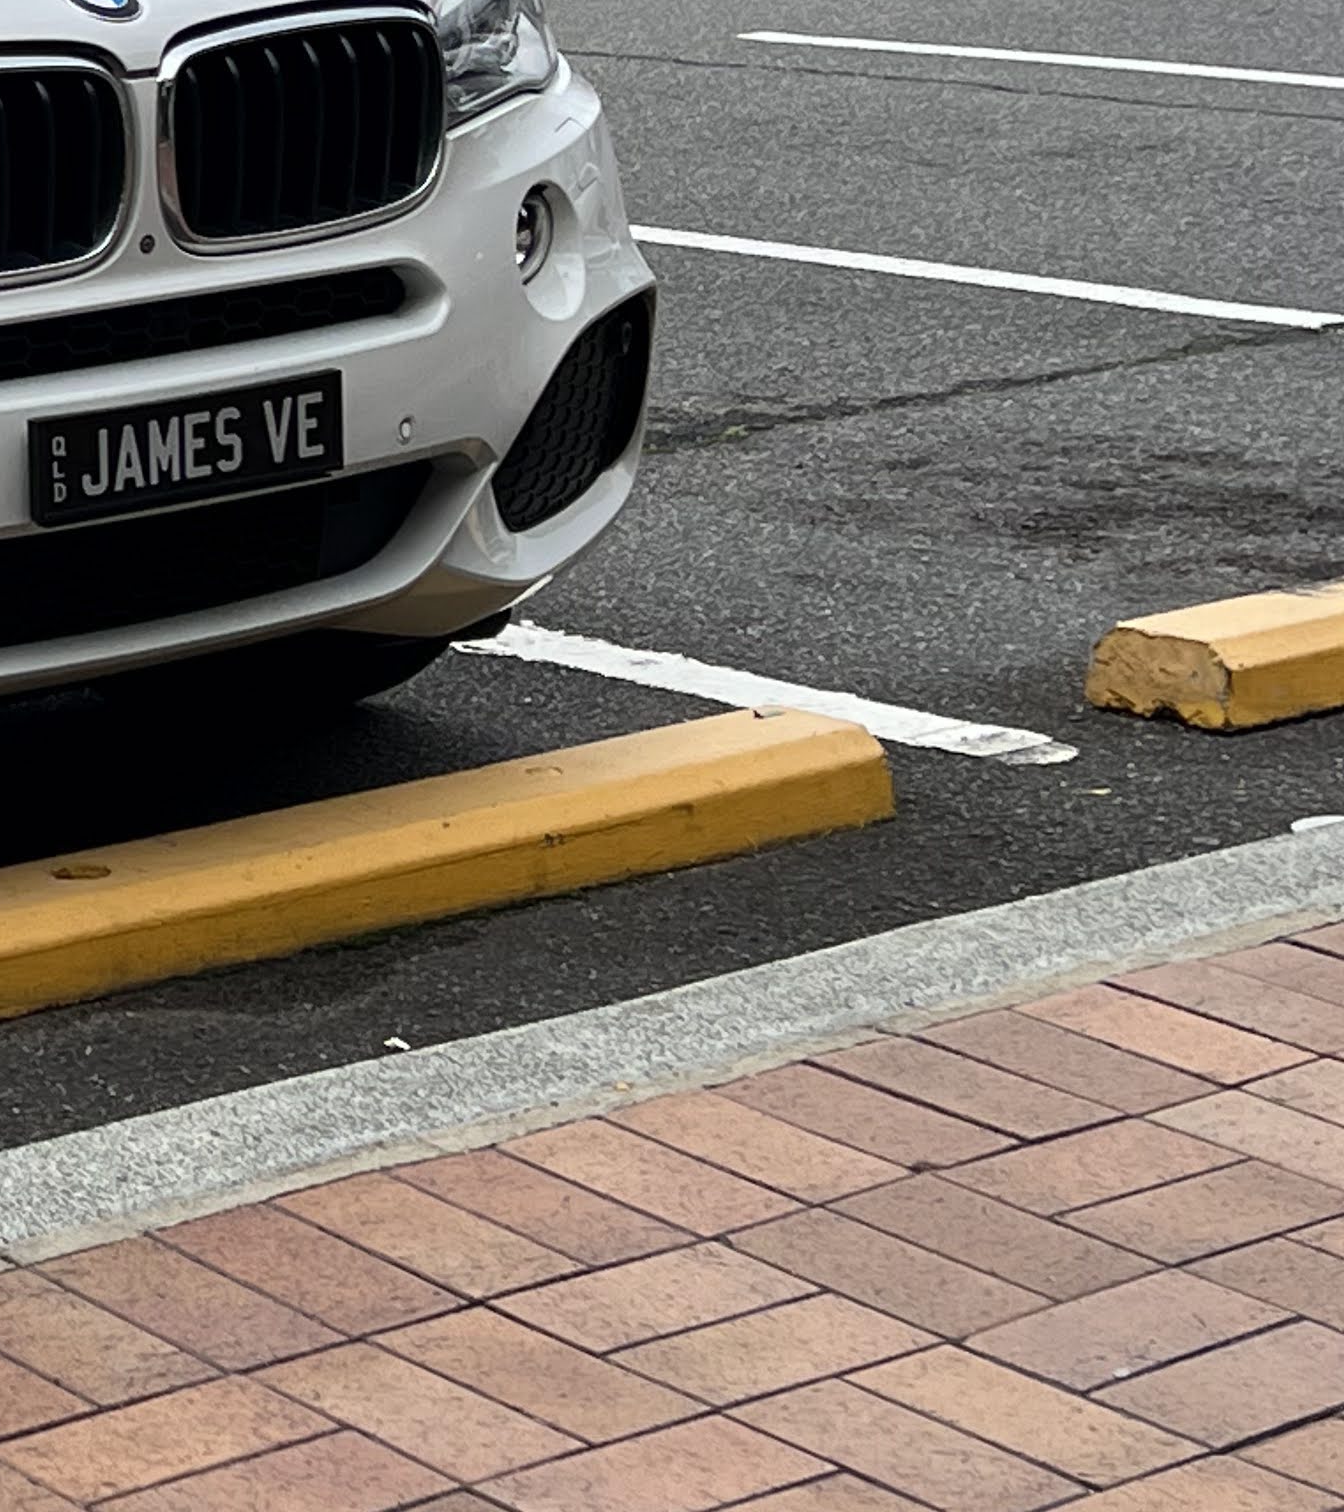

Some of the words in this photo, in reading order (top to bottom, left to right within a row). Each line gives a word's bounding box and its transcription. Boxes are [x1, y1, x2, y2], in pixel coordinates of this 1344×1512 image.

[52, 435, 68, 503] QLD
[81, 406, 243, 496] JAMES
[263, 391, 325, 464] VE
